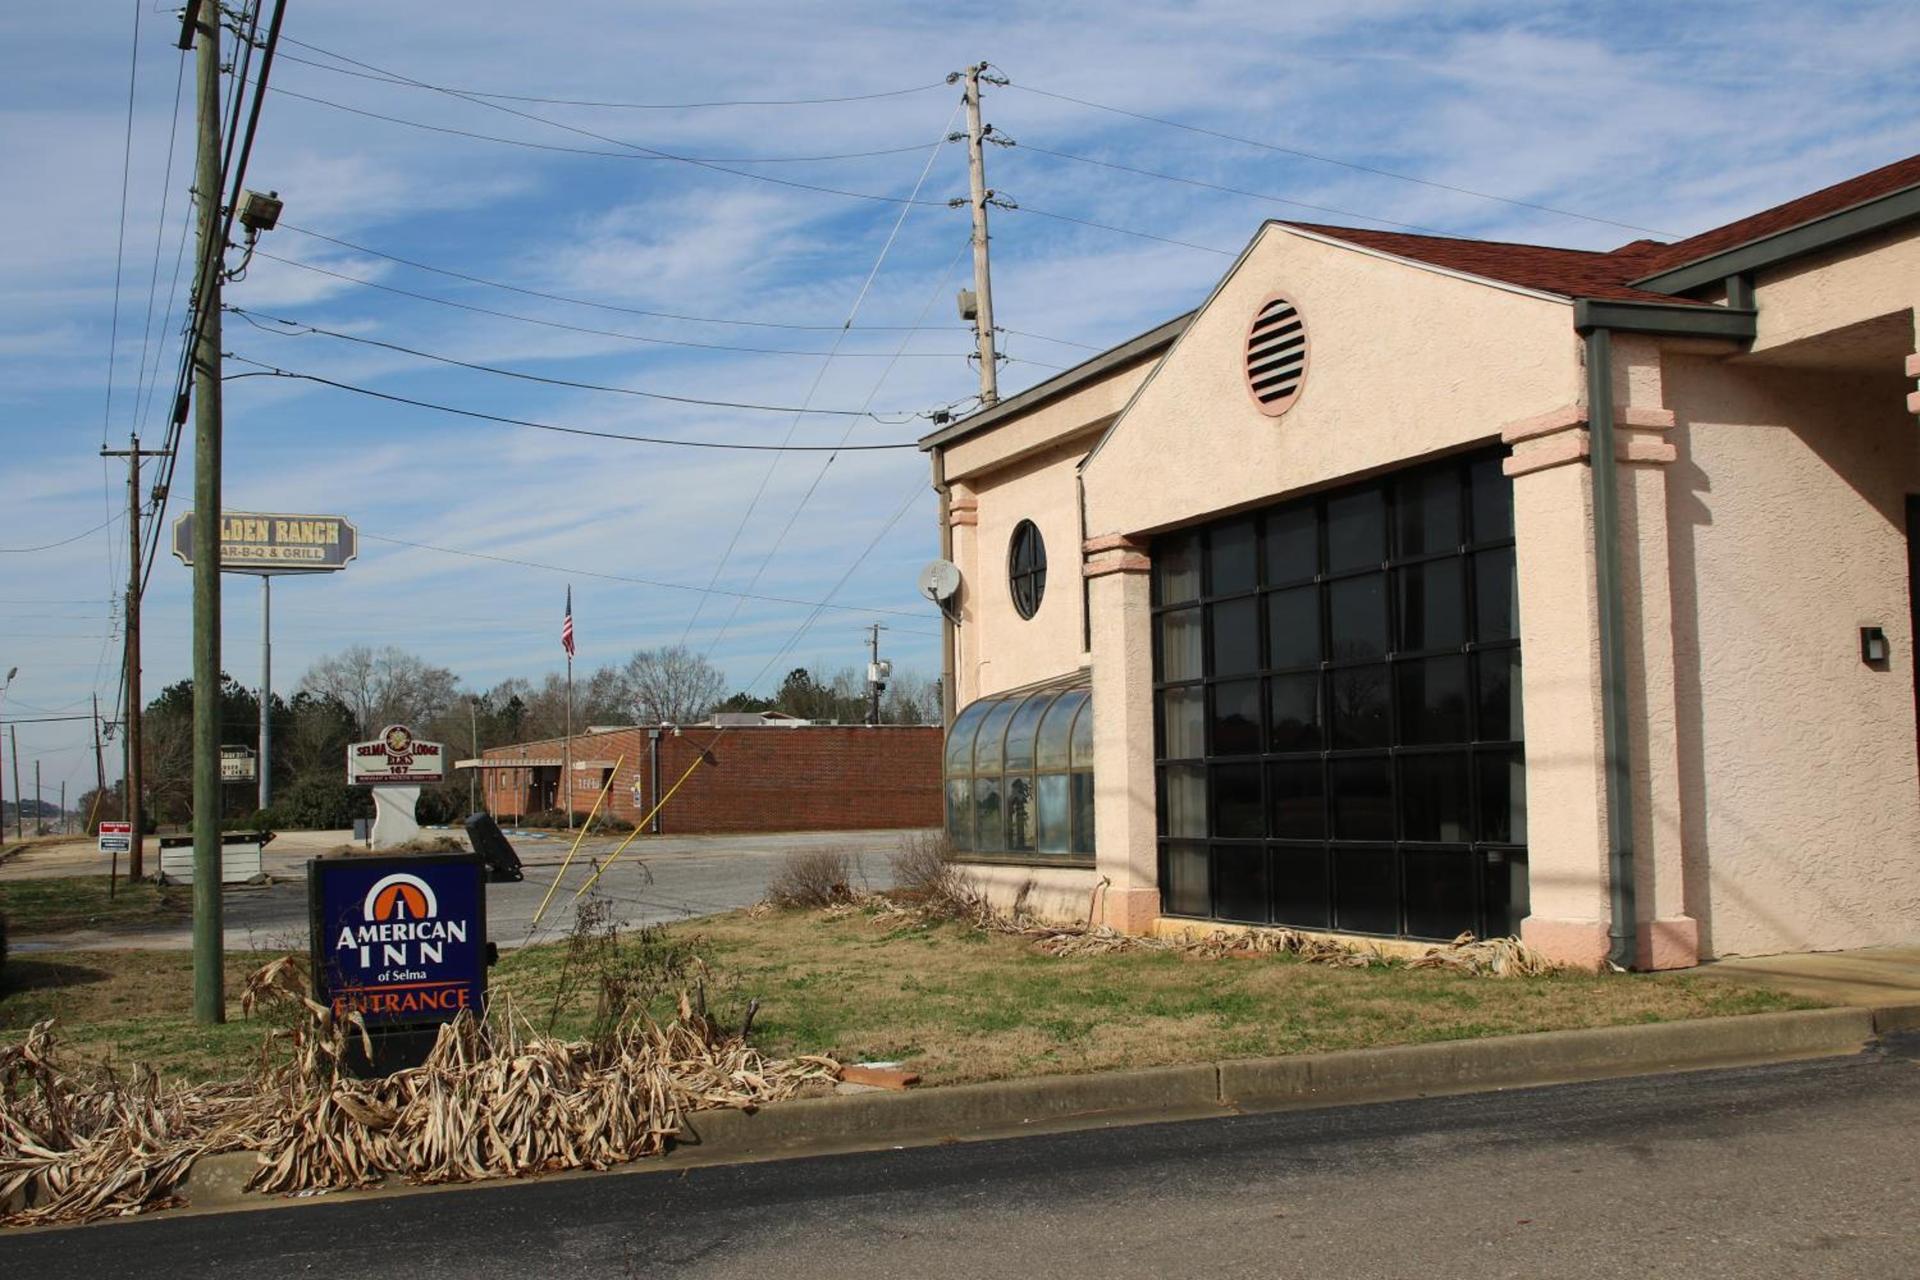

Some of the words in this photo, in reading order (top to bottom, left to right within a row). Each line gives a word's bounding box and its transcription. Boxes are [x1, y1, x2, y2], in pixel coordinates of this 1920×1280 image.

[221, 519, 269, 542] LDEN
[276, 521, 339, 544] RANCH
[221, 546, 264, 557] AR-B-Q
[269, 548, 278, 558] &
[283, 548, 322, 559] GRILL
[357, 743, 387, 756] SELMA
[412, 743, 439, 756] LODGE
[390, 766, 409, 774] 167
[336, 920, 467, 950] AMERICAN
[360, 941, 443, 968] INN
[378, 971, 390, 982] of
[393, 970, 427, 980] Selma
